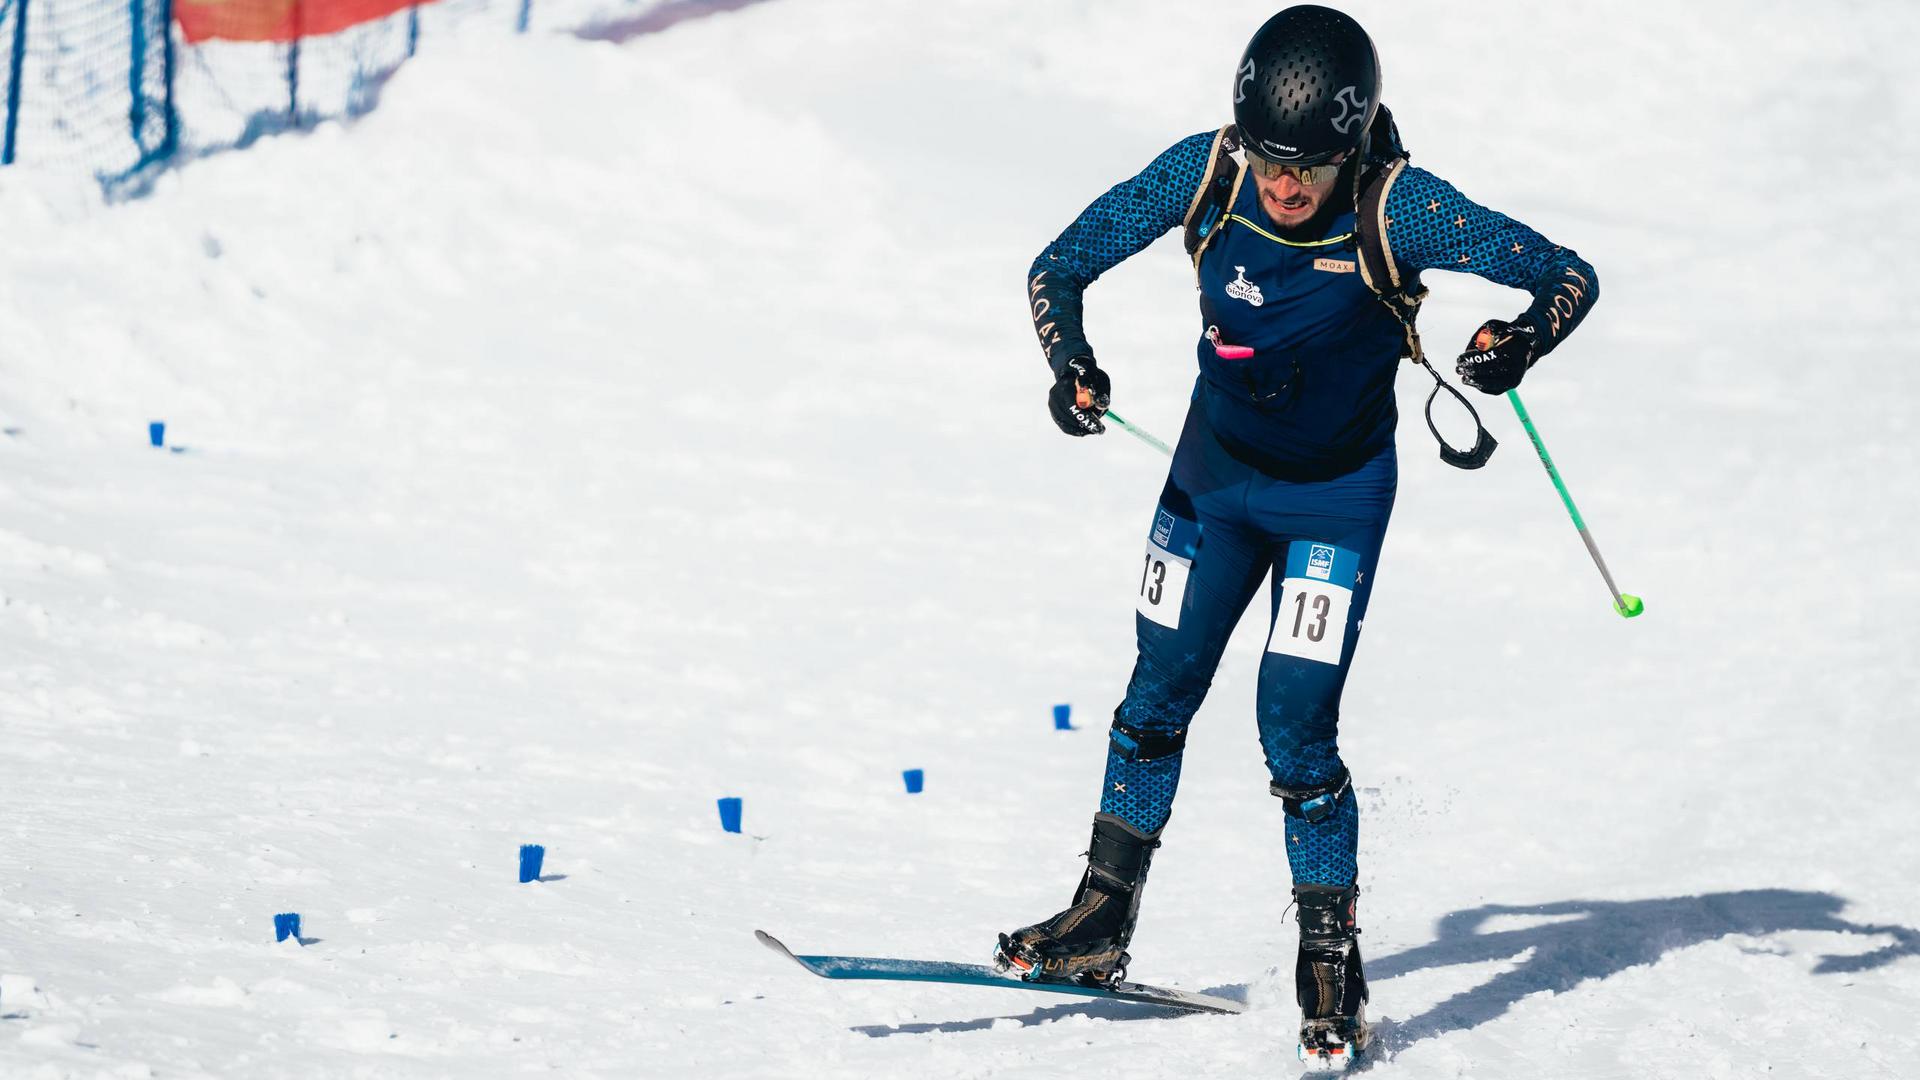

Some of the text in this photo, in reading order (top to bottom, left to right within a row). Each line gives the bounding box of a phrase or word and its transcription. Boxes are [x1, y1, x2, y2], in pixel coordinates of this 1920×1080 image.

[1320, 261, 1349, 271] MOAX
[1226, 284, 1264, 304] bionova
[1465, 350, 1497, 365] MOAX
[1069, 404, 1098, 432] MOAX
[1311, 558, 1330, 568] ISMF
[1140, 553, 1166, 606] 13
[1292, 591, 1331, 643] 13
[1045, 958, 1064, 970] LA
